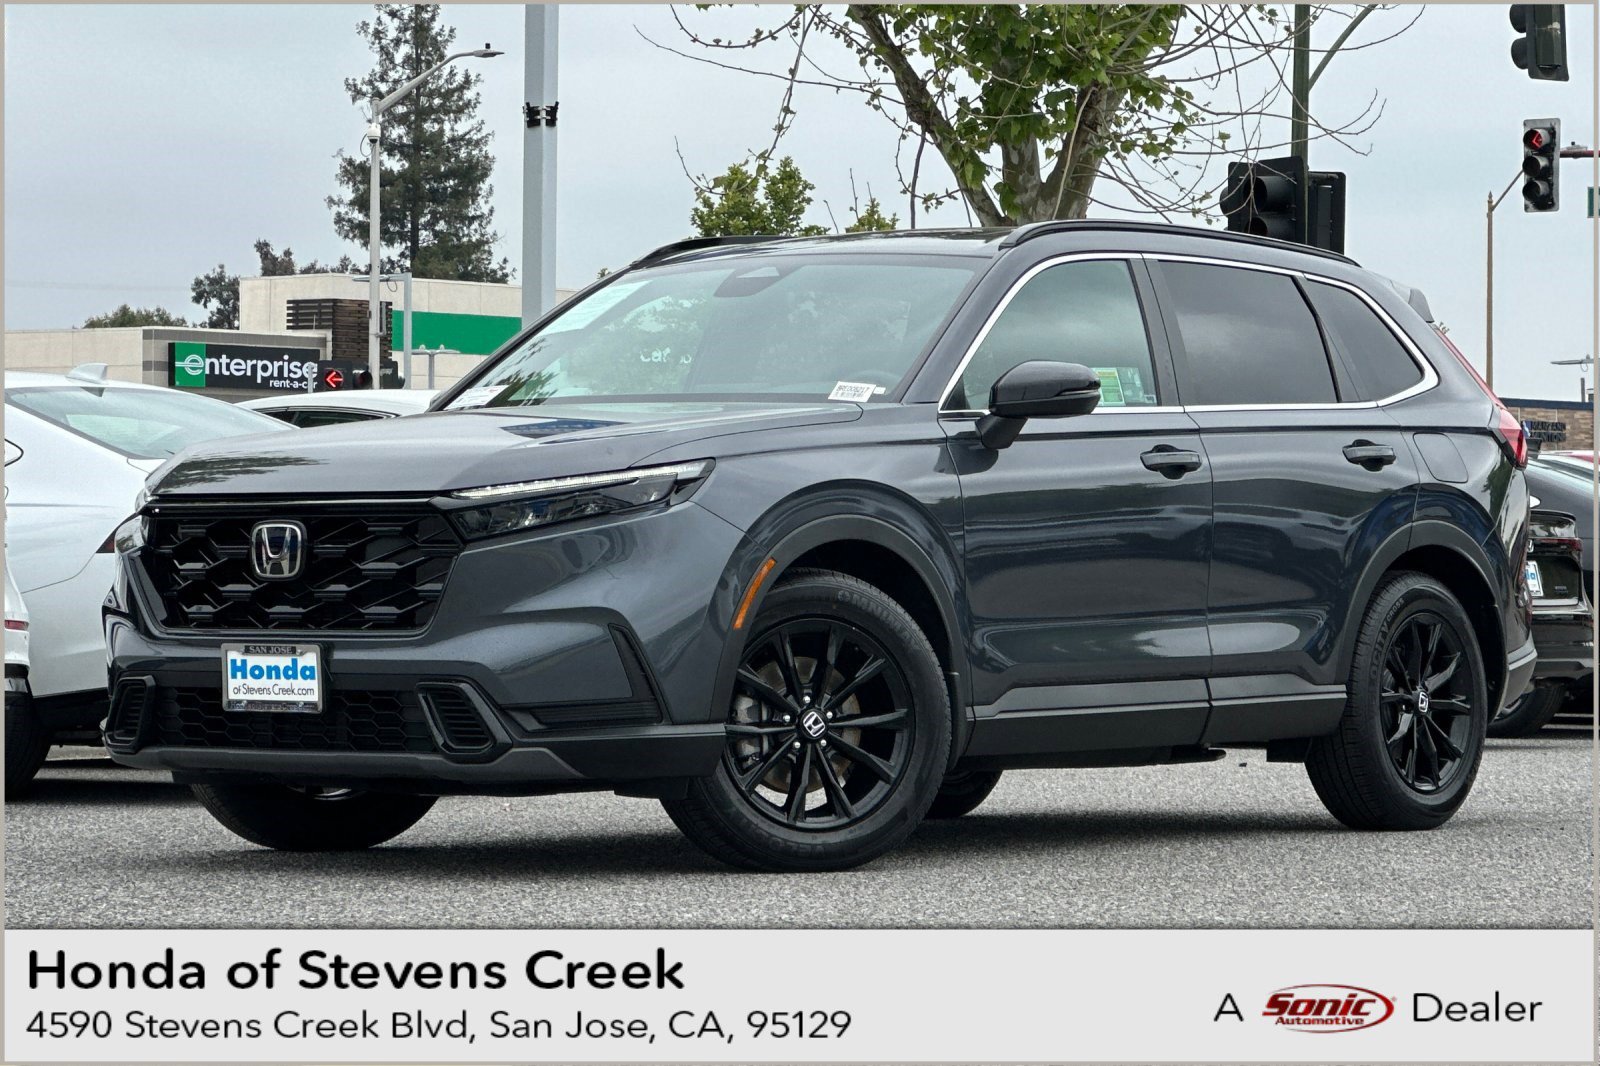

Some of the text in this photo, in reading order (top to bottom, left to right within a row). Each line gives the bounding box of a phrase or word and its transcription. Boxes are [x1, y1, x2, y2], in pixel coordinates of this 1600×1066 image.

[175, 354, 318, 383] enterprise
[269, 379, 318, 390] rent-a-cr
[249, 646, 293, 654] SAN JOSE
[230, 658, 316, 680] Honda
[233, 685, 241, 695] of
